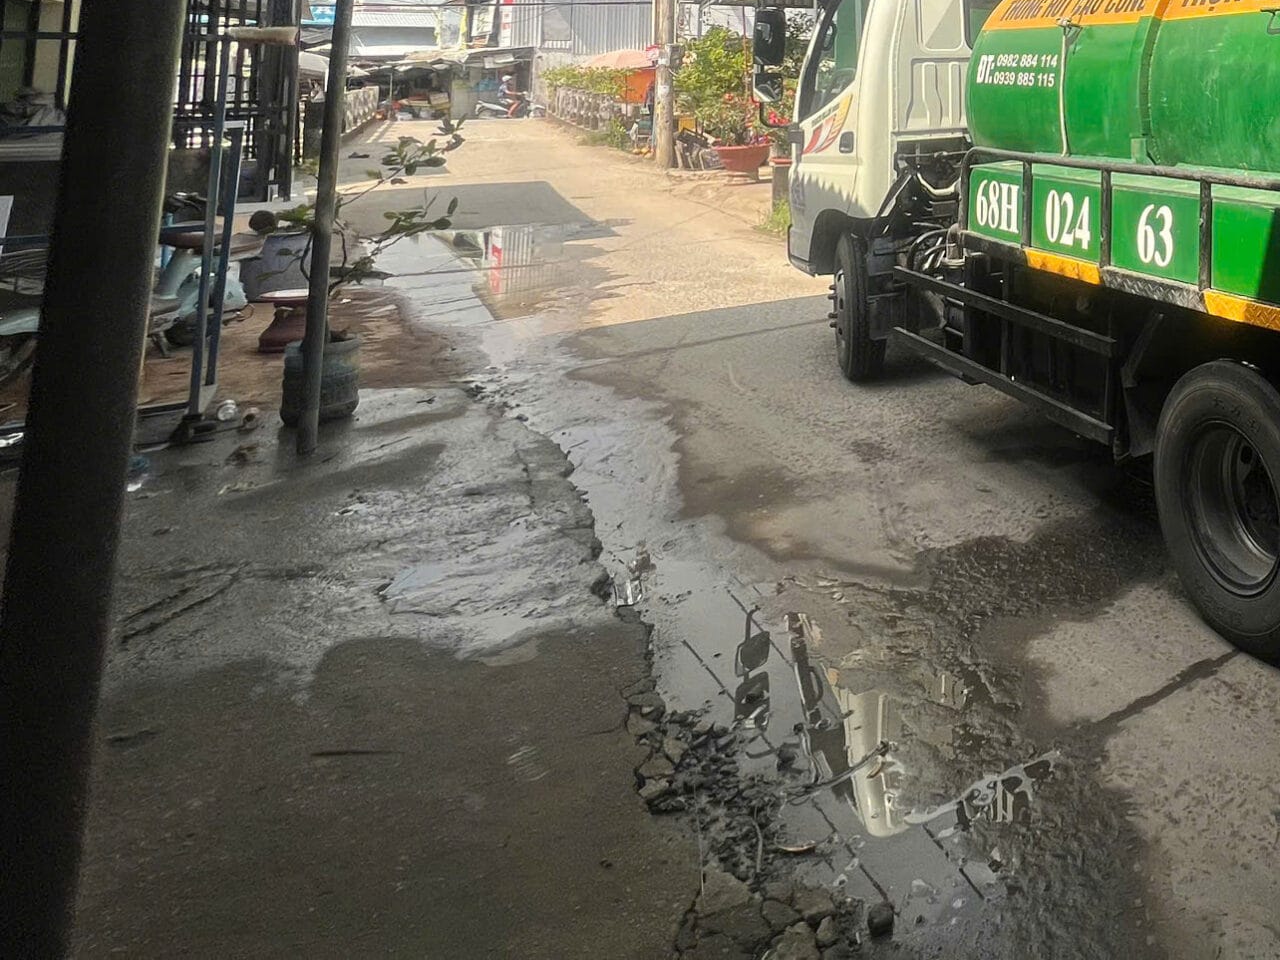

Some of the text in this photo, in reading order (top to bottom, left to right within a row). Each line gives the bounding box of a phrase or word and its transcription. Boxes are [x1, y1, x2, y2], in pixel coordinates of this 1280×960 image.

[996, 53, 1019, 67] 0982
[1020, 53, 1038, 68] 884
[1041, 54, 1058, 68] 114
[993, 71, 1055, 87] 0939 885 115
[976, 179, 1174, 267] 68H 024 63
